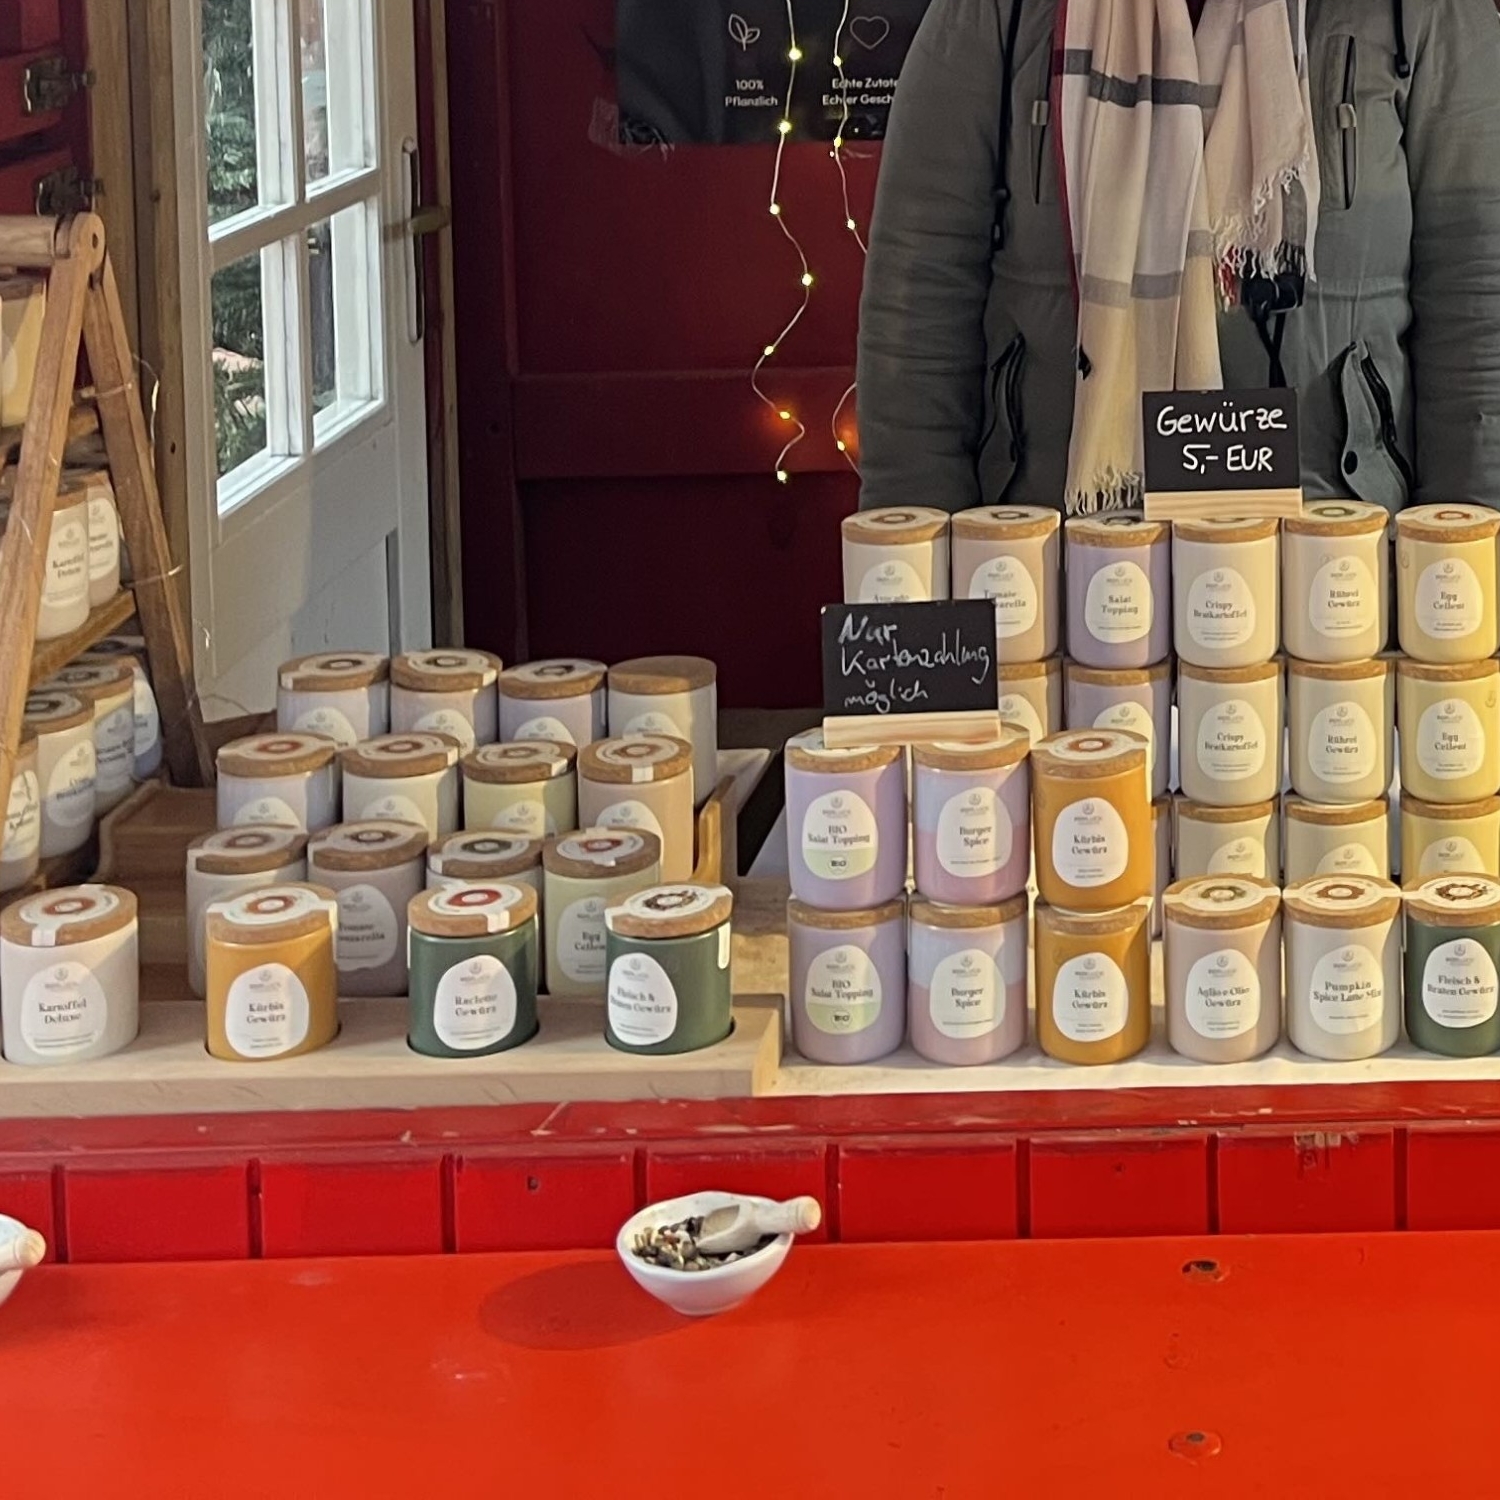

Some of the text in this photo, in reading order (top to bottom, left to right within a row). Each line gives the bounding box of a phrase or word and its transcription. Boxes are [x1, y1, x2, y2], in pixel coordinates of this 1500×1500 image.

[735, 79, 764, 91] 100%
[725, 95, 779, 107] Pflanzlich
[1157, 401, 1288, 436] Gewürze
[1226, 444, 1274, 473] EUR
[844, 678, 928, 714] möglich
[958, 826, 992, 838] Burger
[831, 833, 870, 846] Topping
[963, 837, 989, 849] Spice
[1437, 975, 1472, 986] Fleisch
[1324, 981, 1371, 993] Pumpkin
[834, 988, 874, 1000] Topping
[38, 998, 88, 1013] Kartoffel
